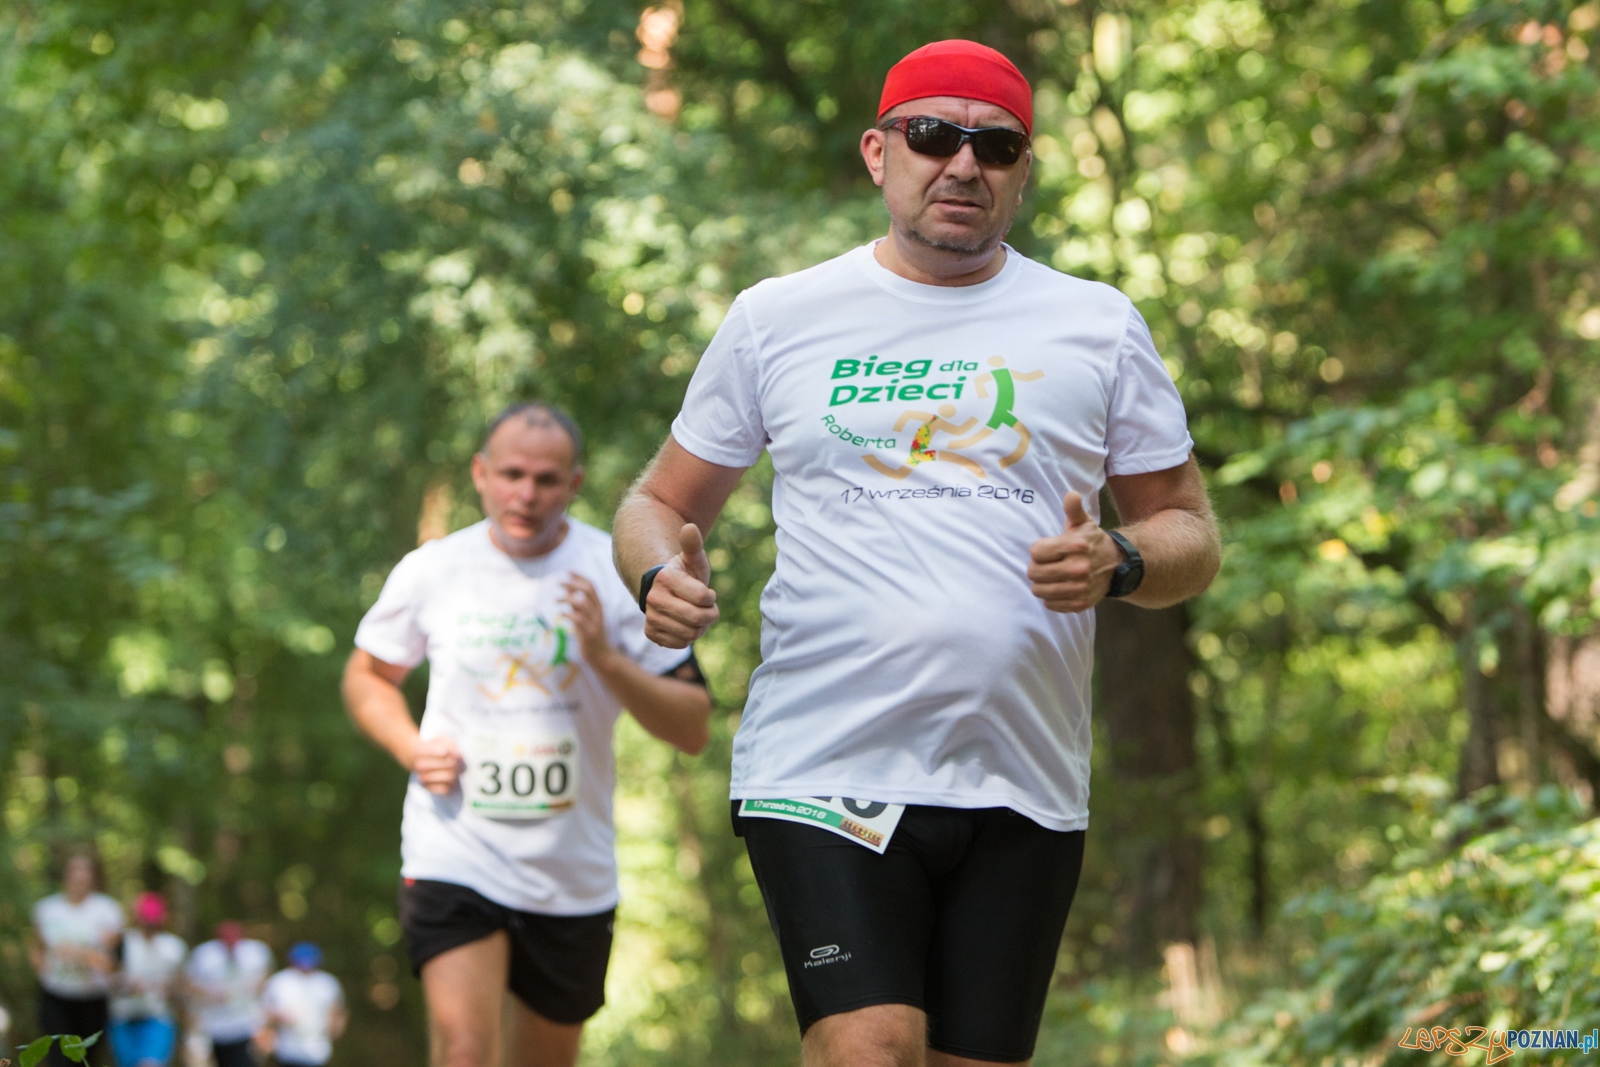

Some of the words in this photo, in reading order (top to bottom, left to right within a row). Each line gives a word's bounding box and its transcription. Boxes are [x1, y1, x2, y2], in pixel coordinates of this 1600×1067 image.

[830, 355, 933, 380] Bieg
[939, 360, 979, 372] dla
[828, 376, 967, 407] Dzieci
[820, 414, 896, 449] Roberta
[841, 487, 863, 504] 17
[868, 484, 972, 500] września
[977, 485, 1035, 504] 2016
[481, 761, 568, 797] 300
[796, 806, 828, 820] 2016
